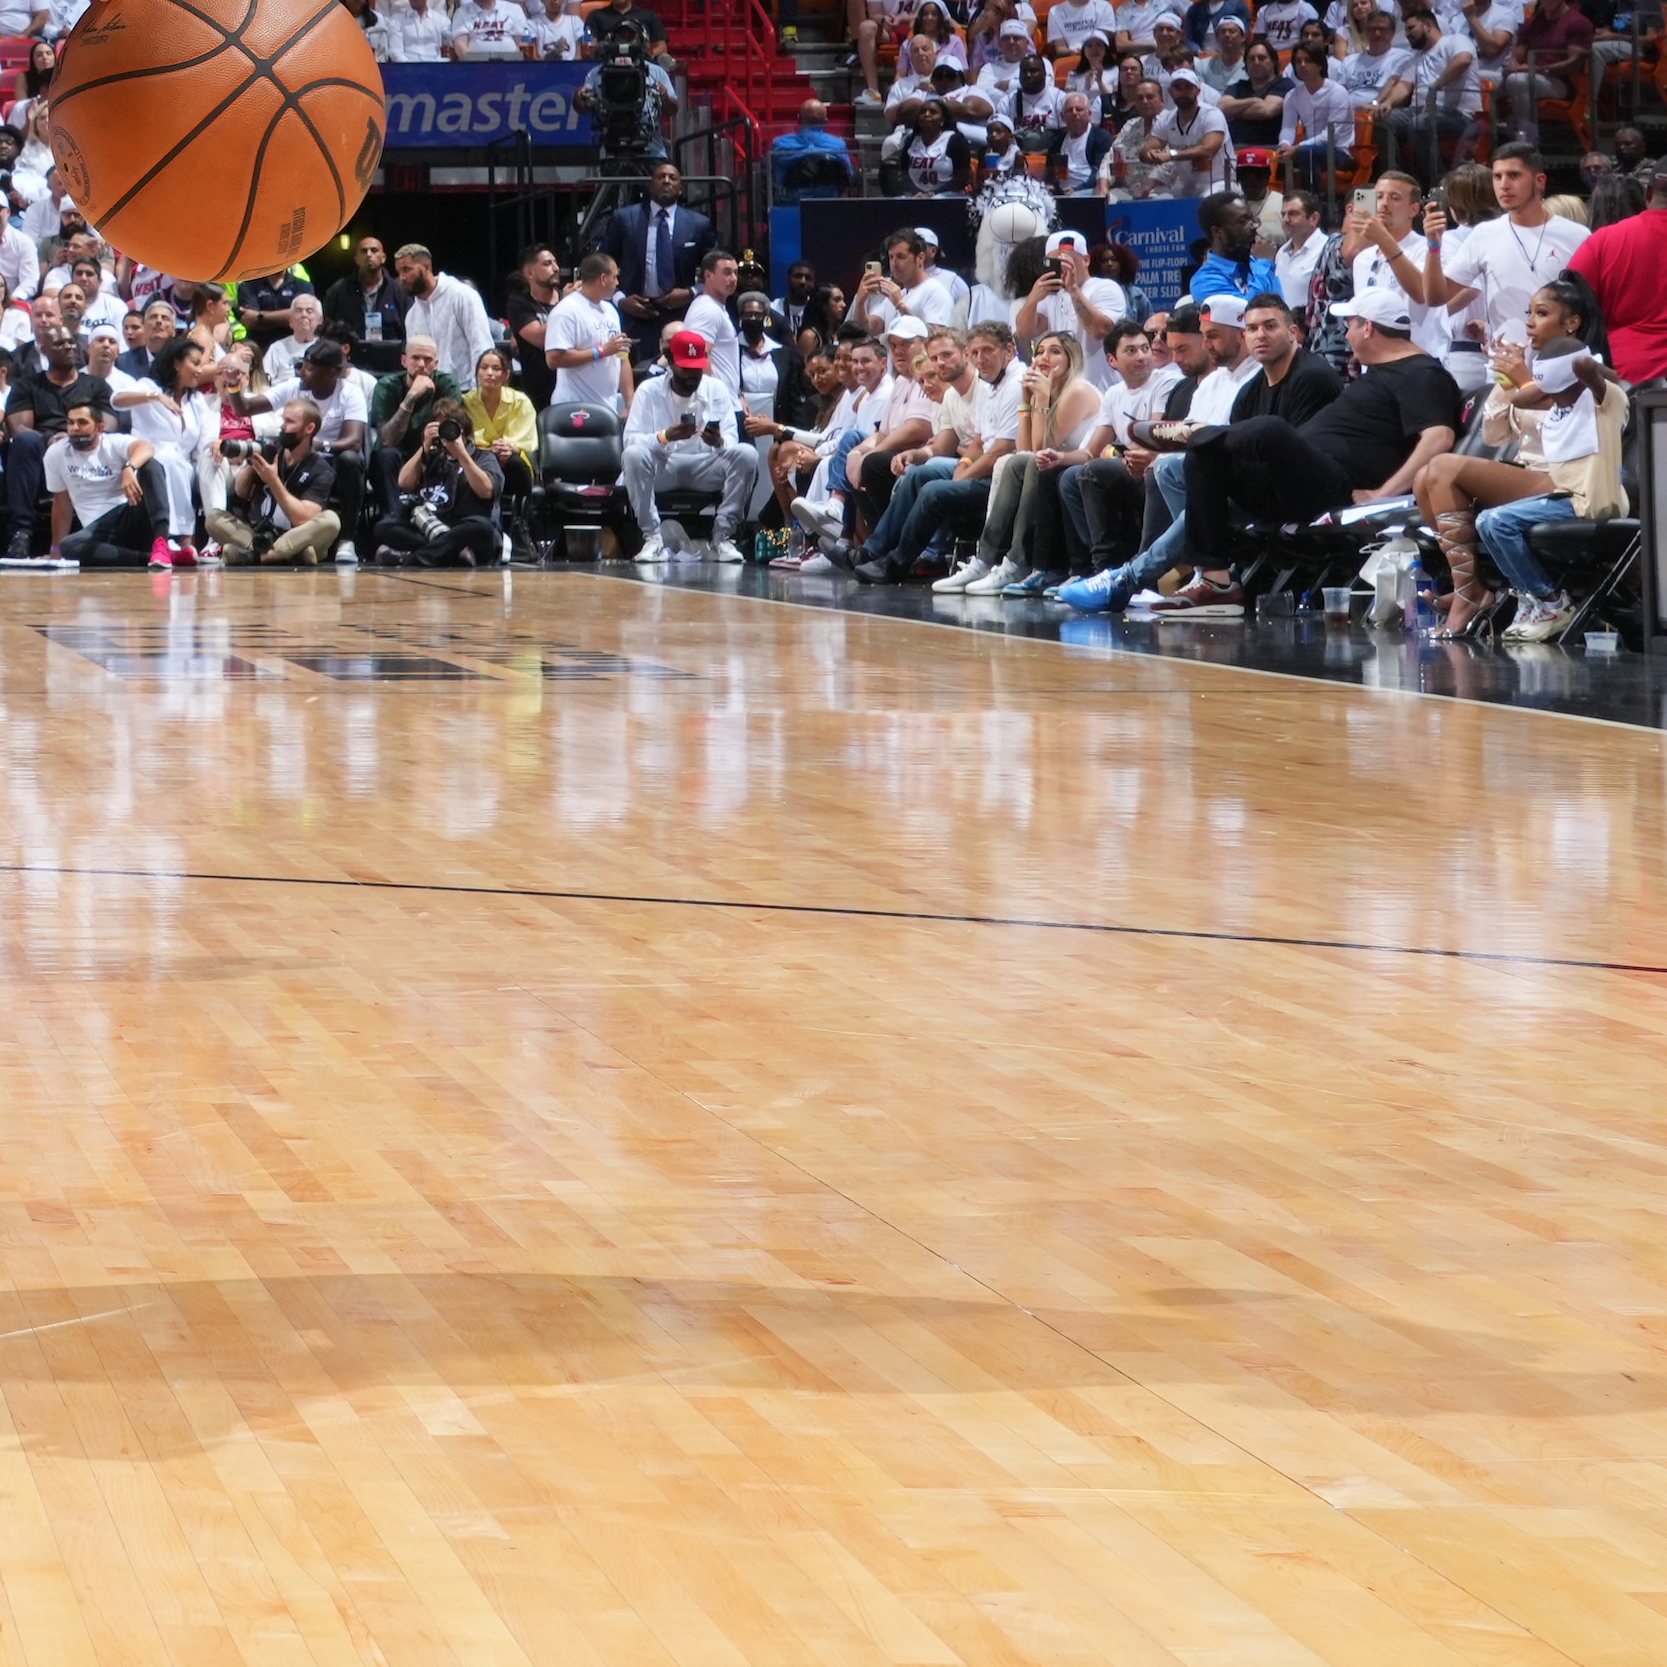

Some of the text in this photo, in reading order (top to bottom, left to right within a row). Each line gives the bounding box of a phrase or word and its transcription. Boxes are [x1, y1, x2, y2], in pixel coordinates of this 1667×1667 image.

[896, 0, 915, 15] 14
[473, 18, 509, 30] HEAT
[1112, 224, 1191, 245] Carnival
[1135, 271, 1182, 284] PALM TRE
[1159, 286, 1182, 297] SLID
